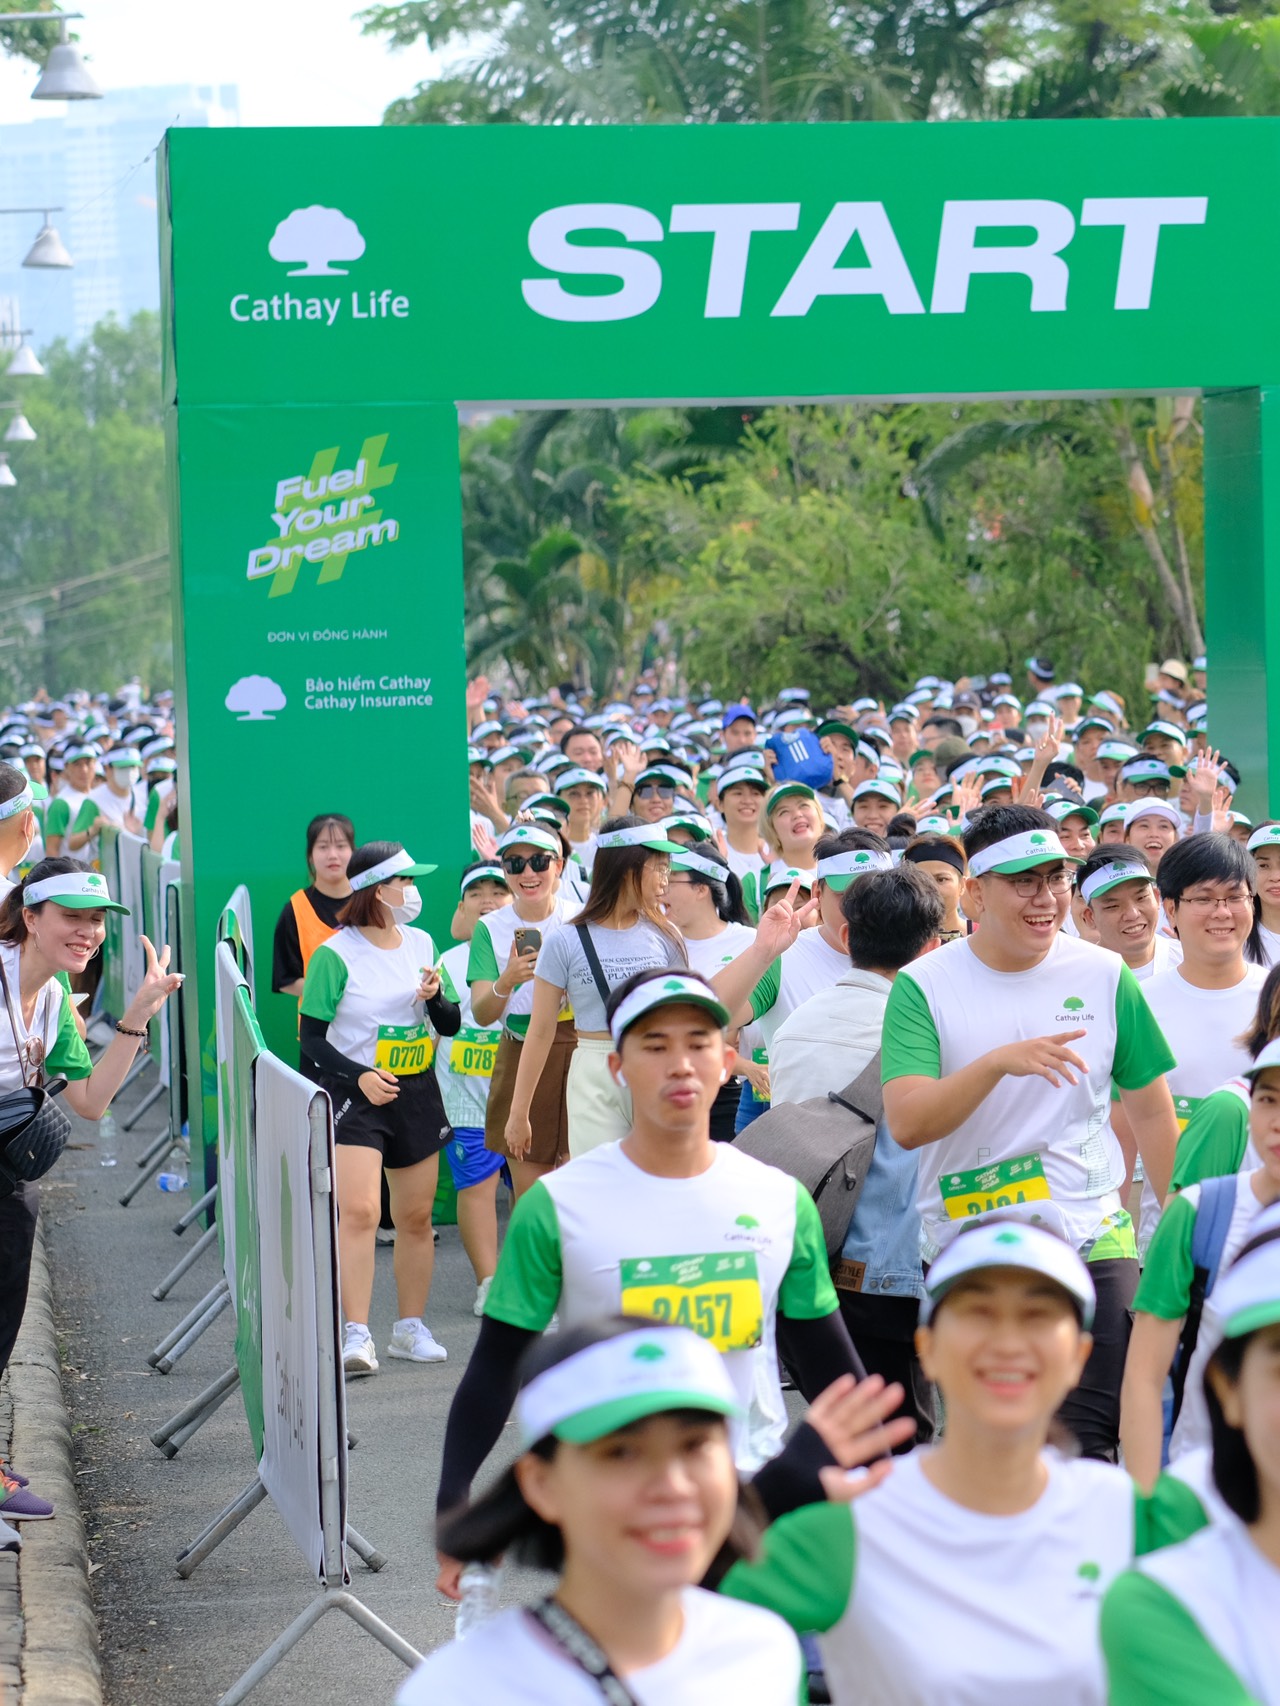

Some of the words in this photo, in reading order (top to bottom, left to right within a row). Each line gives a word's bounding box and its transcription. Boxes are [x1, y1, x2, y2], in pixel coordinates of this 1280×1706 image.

[521, 196, 1208, 322] START
[229, 292, 341, 326] Cathay
[352, 289, 410, 319] Life
[275, 458, 369, 511] Fuel
[271, 494, 375, 541] Your
[246, 518, 400, 581] Dream
[305, 677, 335, 692] Bảo
[338, 675, 375, 692] hiểm
[379, 675, 431, 692] Cathay
[304, 694, 357, 711] Cathay
[360, 694, 433, 708] Insurance
[1026, 847, 1047, 855] Cathay
[1055, 1014, 1080, 1022] Cathay
[1081, 1013, 1095, 1021] Life
[389, 1044, 425, 1068] 0770
[463, 1047, 496, 1071] 078
[652, 1292, 733, 1339] 2457
